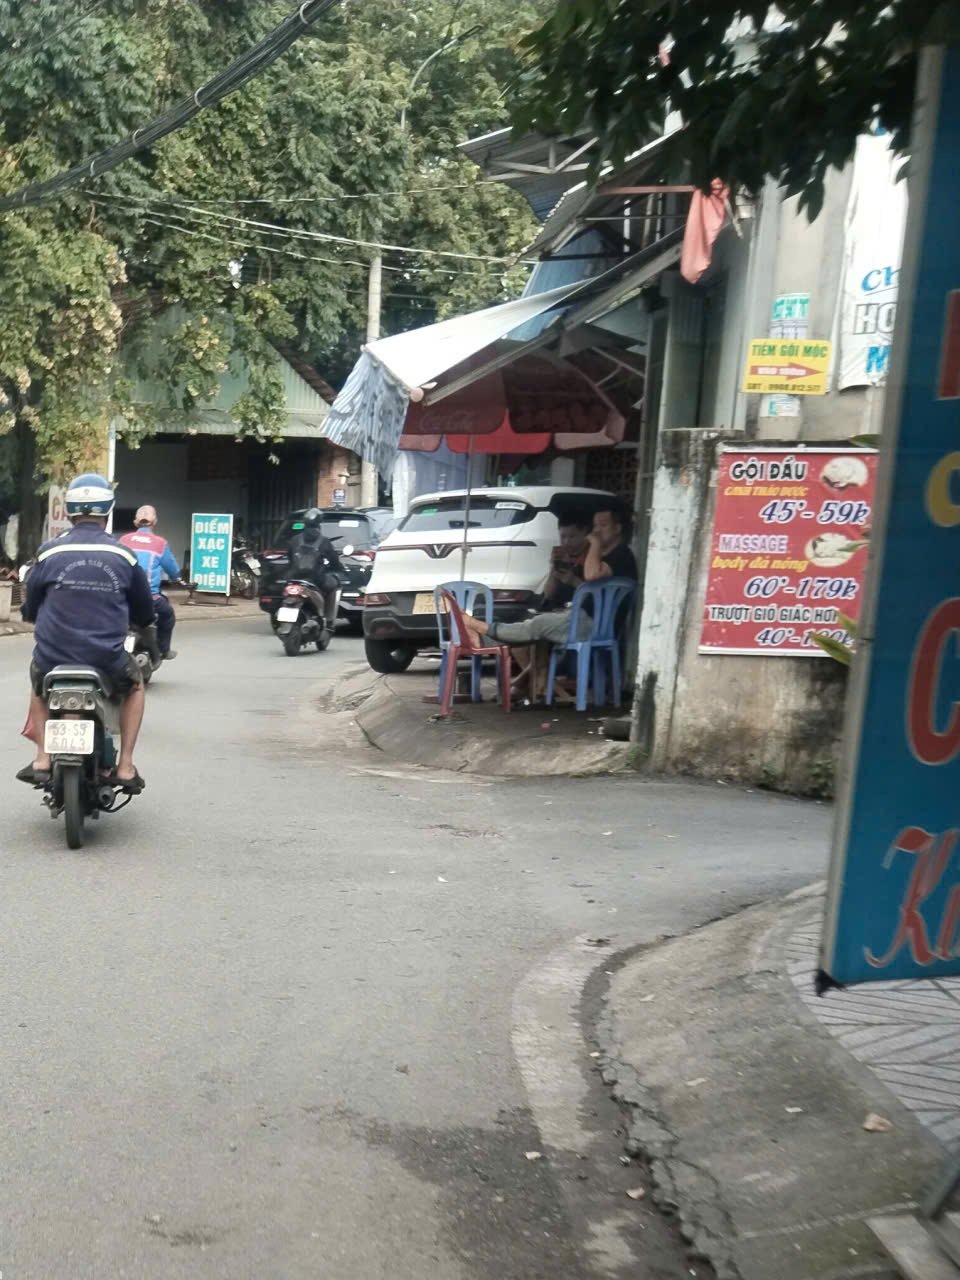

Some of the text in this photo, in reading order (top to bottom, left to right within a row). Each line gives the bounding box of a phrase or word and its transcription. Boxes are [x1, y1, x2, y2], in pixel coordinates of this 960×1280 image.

[730, 457, 765, 484] GỘI
[721, 535, 788, 553] MASSAGE
[201, 555, 220, 568] XE
[711, 556, 748, 571] body
[771, 558, 809, 573] nóng
[710, 604, 751, 624] TRƯỢT
[754, 605, 777, 621] GIÓ
[780, 604, 811, 621] GIÁC
